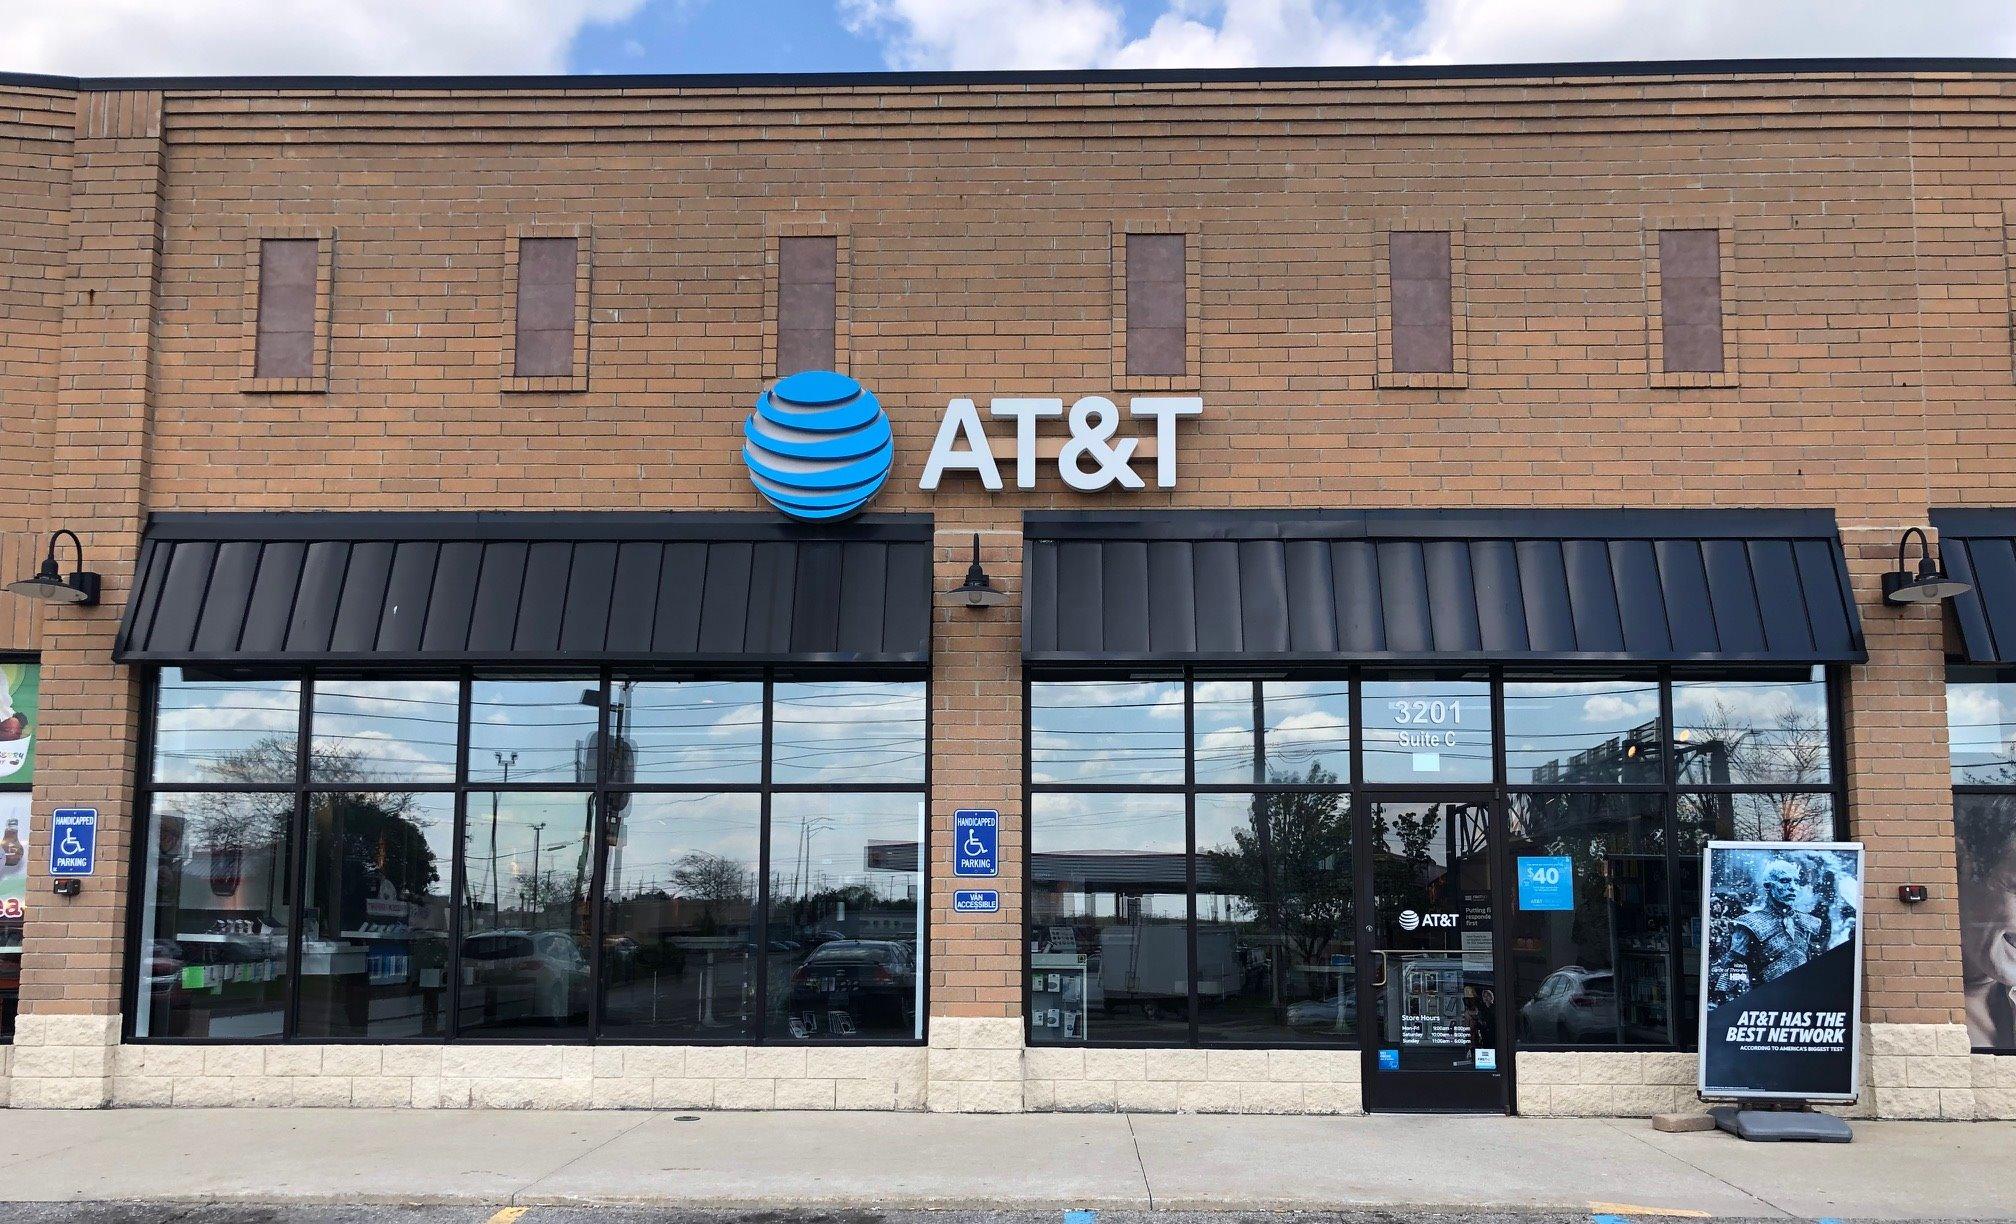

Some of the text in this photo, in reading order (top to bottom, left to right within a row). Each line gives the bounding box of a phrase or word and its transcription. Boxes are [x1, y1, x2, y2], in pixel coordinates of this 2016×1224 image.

[919, 396, 1203, 491] AT&T
[1394, 700, 1460, 724] 3201
[1399, 730, 1456, 747] Suite C
[55, 816, 94, 826] HANDICAPPED
[957, 818, 995, 827] HANDICAPPED
[57, 858, 87, 867] PARKING
[961, 859, 991, 868] PARKING
[1527, 867, 1559, 885] $40
[970, 893, 984, 901] VAN
[0, 897, 22, 918] a
[1421, 914, 1459, 927] AT&T
[1737, 1011, 1846, 1027] AT&T HAS THE
[1726, 1027, 1846, 1043] BEST NETWORK
